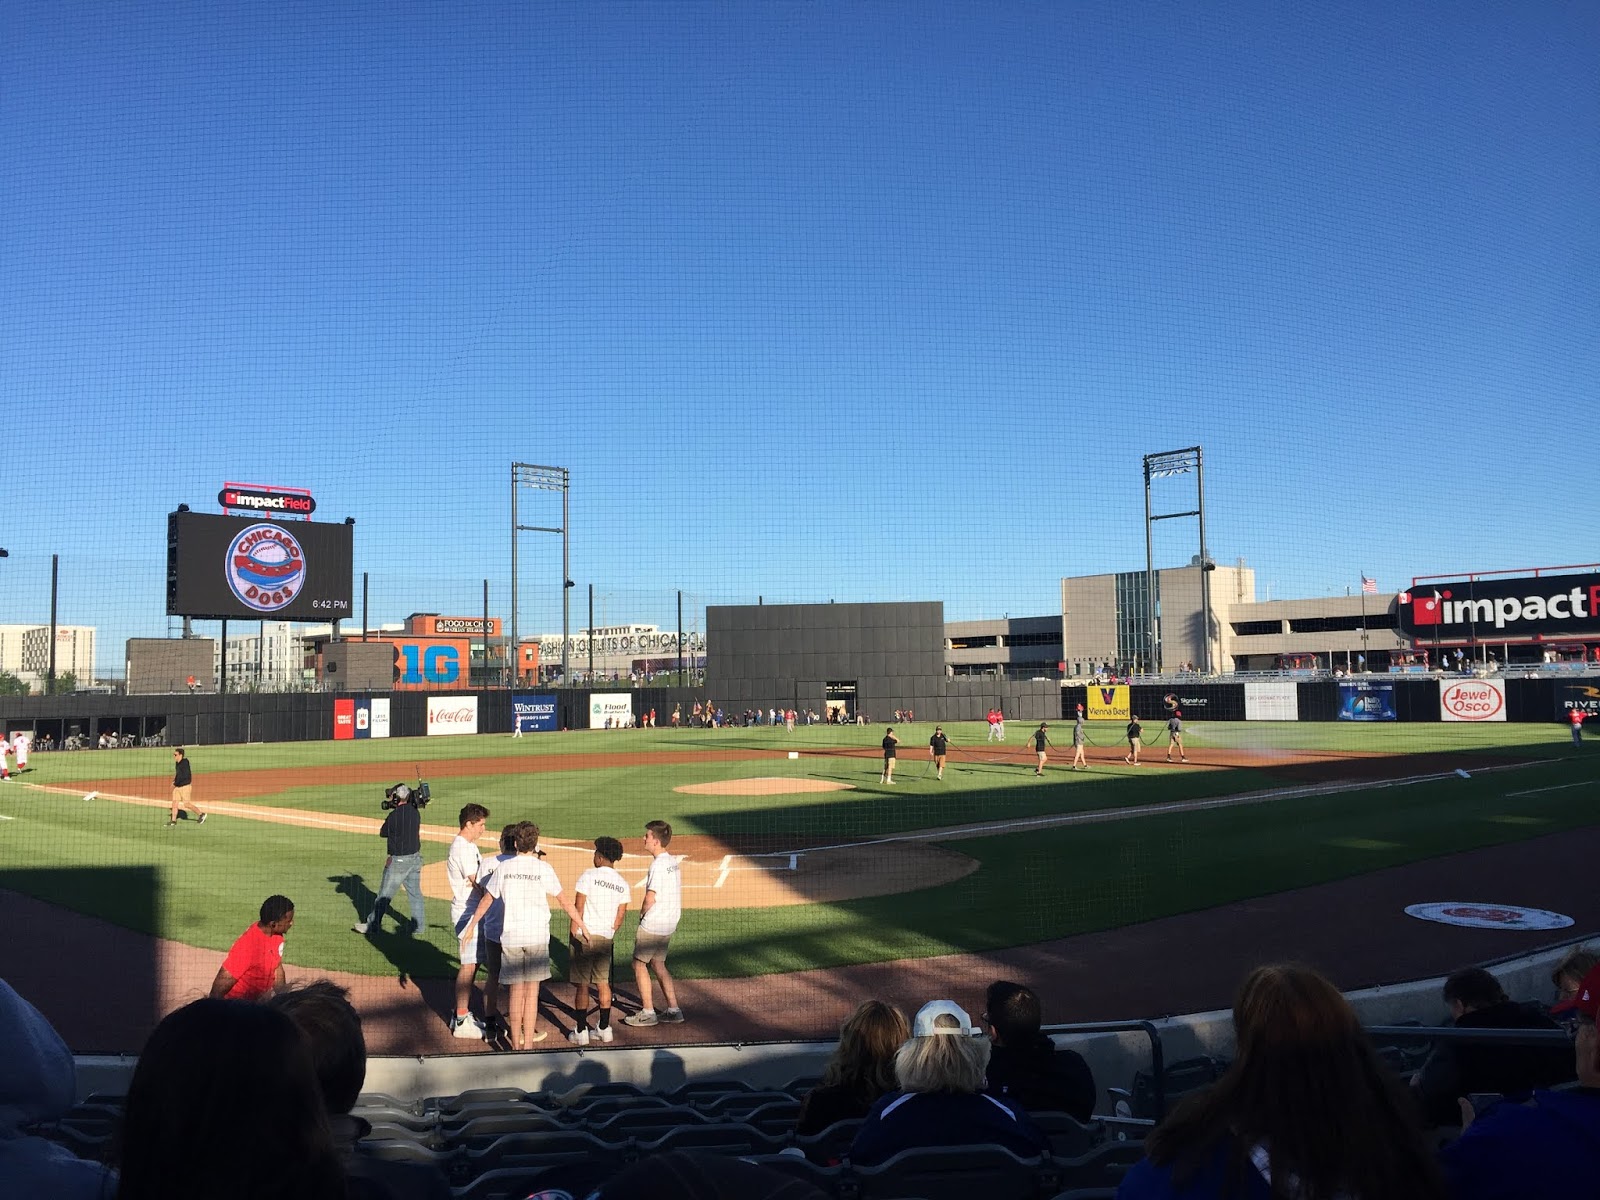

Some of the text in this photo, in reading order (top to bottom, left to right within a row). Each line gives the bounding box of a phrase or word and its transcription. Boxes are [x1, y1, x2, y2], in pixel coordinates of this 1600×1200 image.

[238, 529, 300, 558] CHICAGO
[245, 586, 293, 605] DOGS
[312, 599, 348, 609] 6:42 PM
[473, 620, 494, 628] CHO
[621, 636, 636, 650] OF
[639, 631, 697, 649] CHICAGO
[1451, 688, 1492, 700] Jewel
[1453, 700, 1491, 711] Osco
[1088, 708, 1129, 717] Vienna Beef
[594, 879, 625, 893] HOWARD
